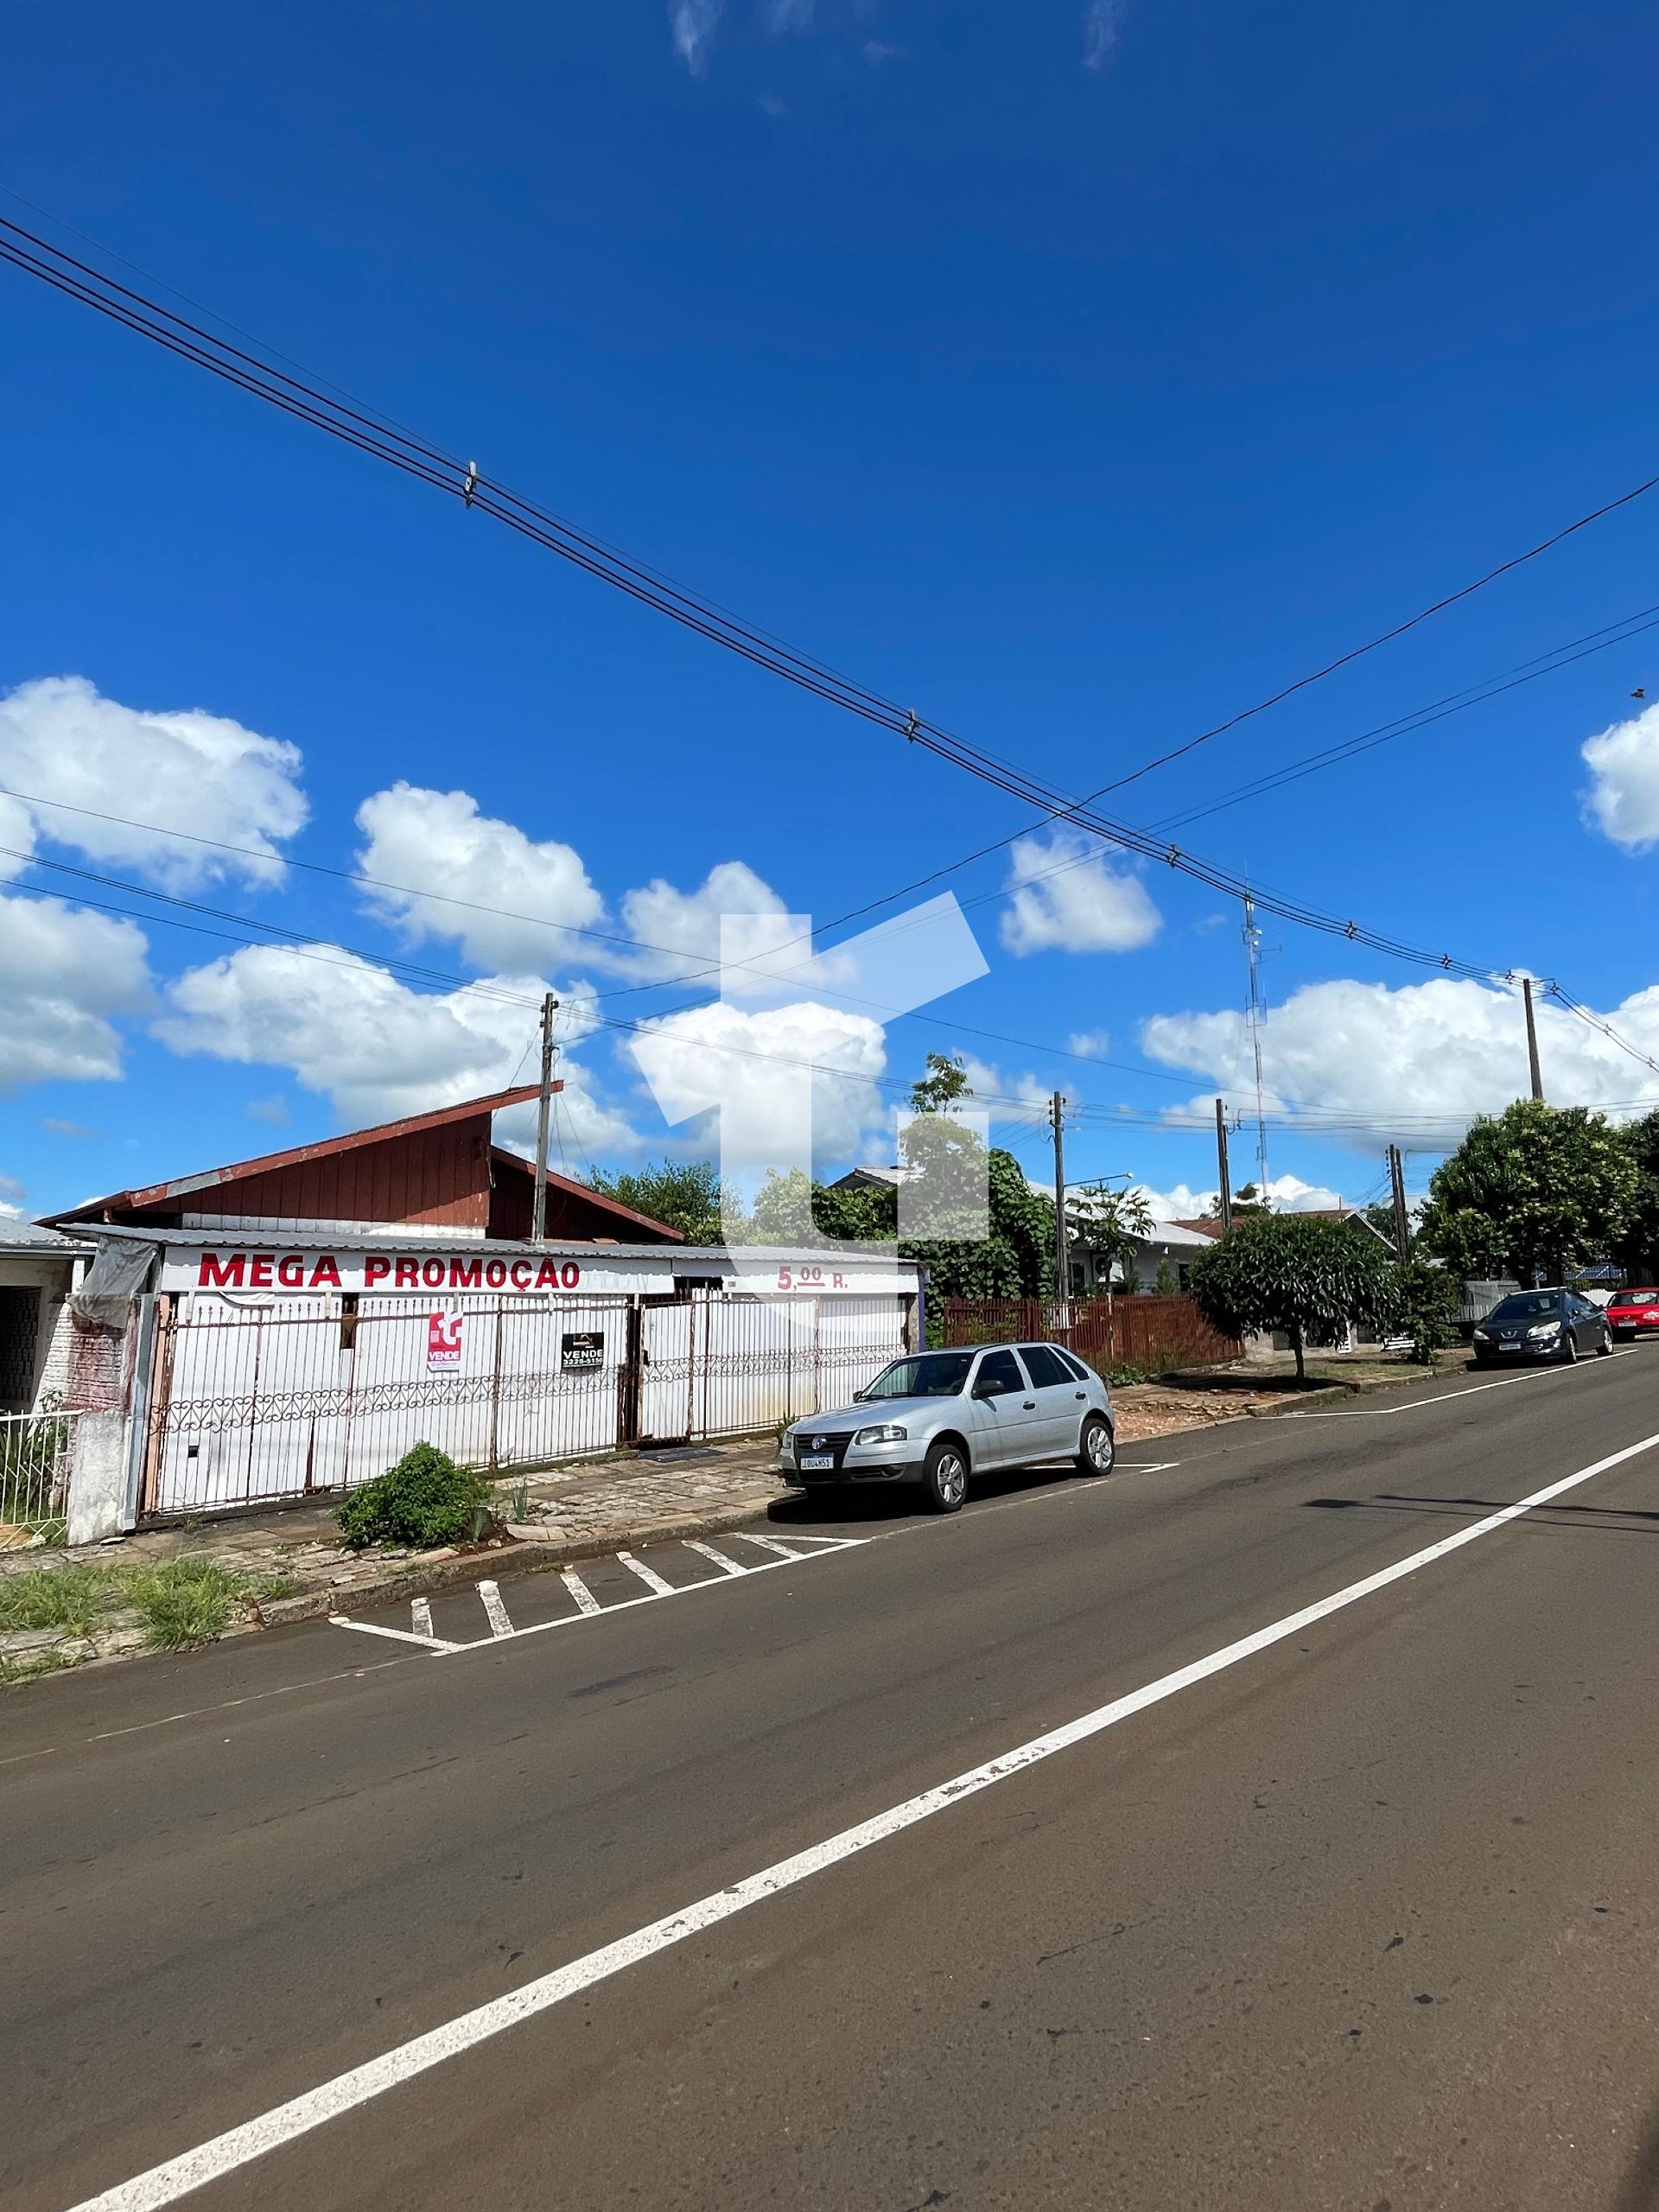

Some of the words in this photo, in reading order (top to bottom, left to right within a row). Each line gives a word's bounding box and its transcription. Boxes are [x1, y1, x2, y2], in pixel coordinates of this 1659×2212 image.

[198, 1253, 342, 1287] MEGA
[364, 1256, 581, 1292] PROMOÇÃO
[428, 1351, 460, 1361] VENDE
[563, 1349, 603, 1359] VENDE
